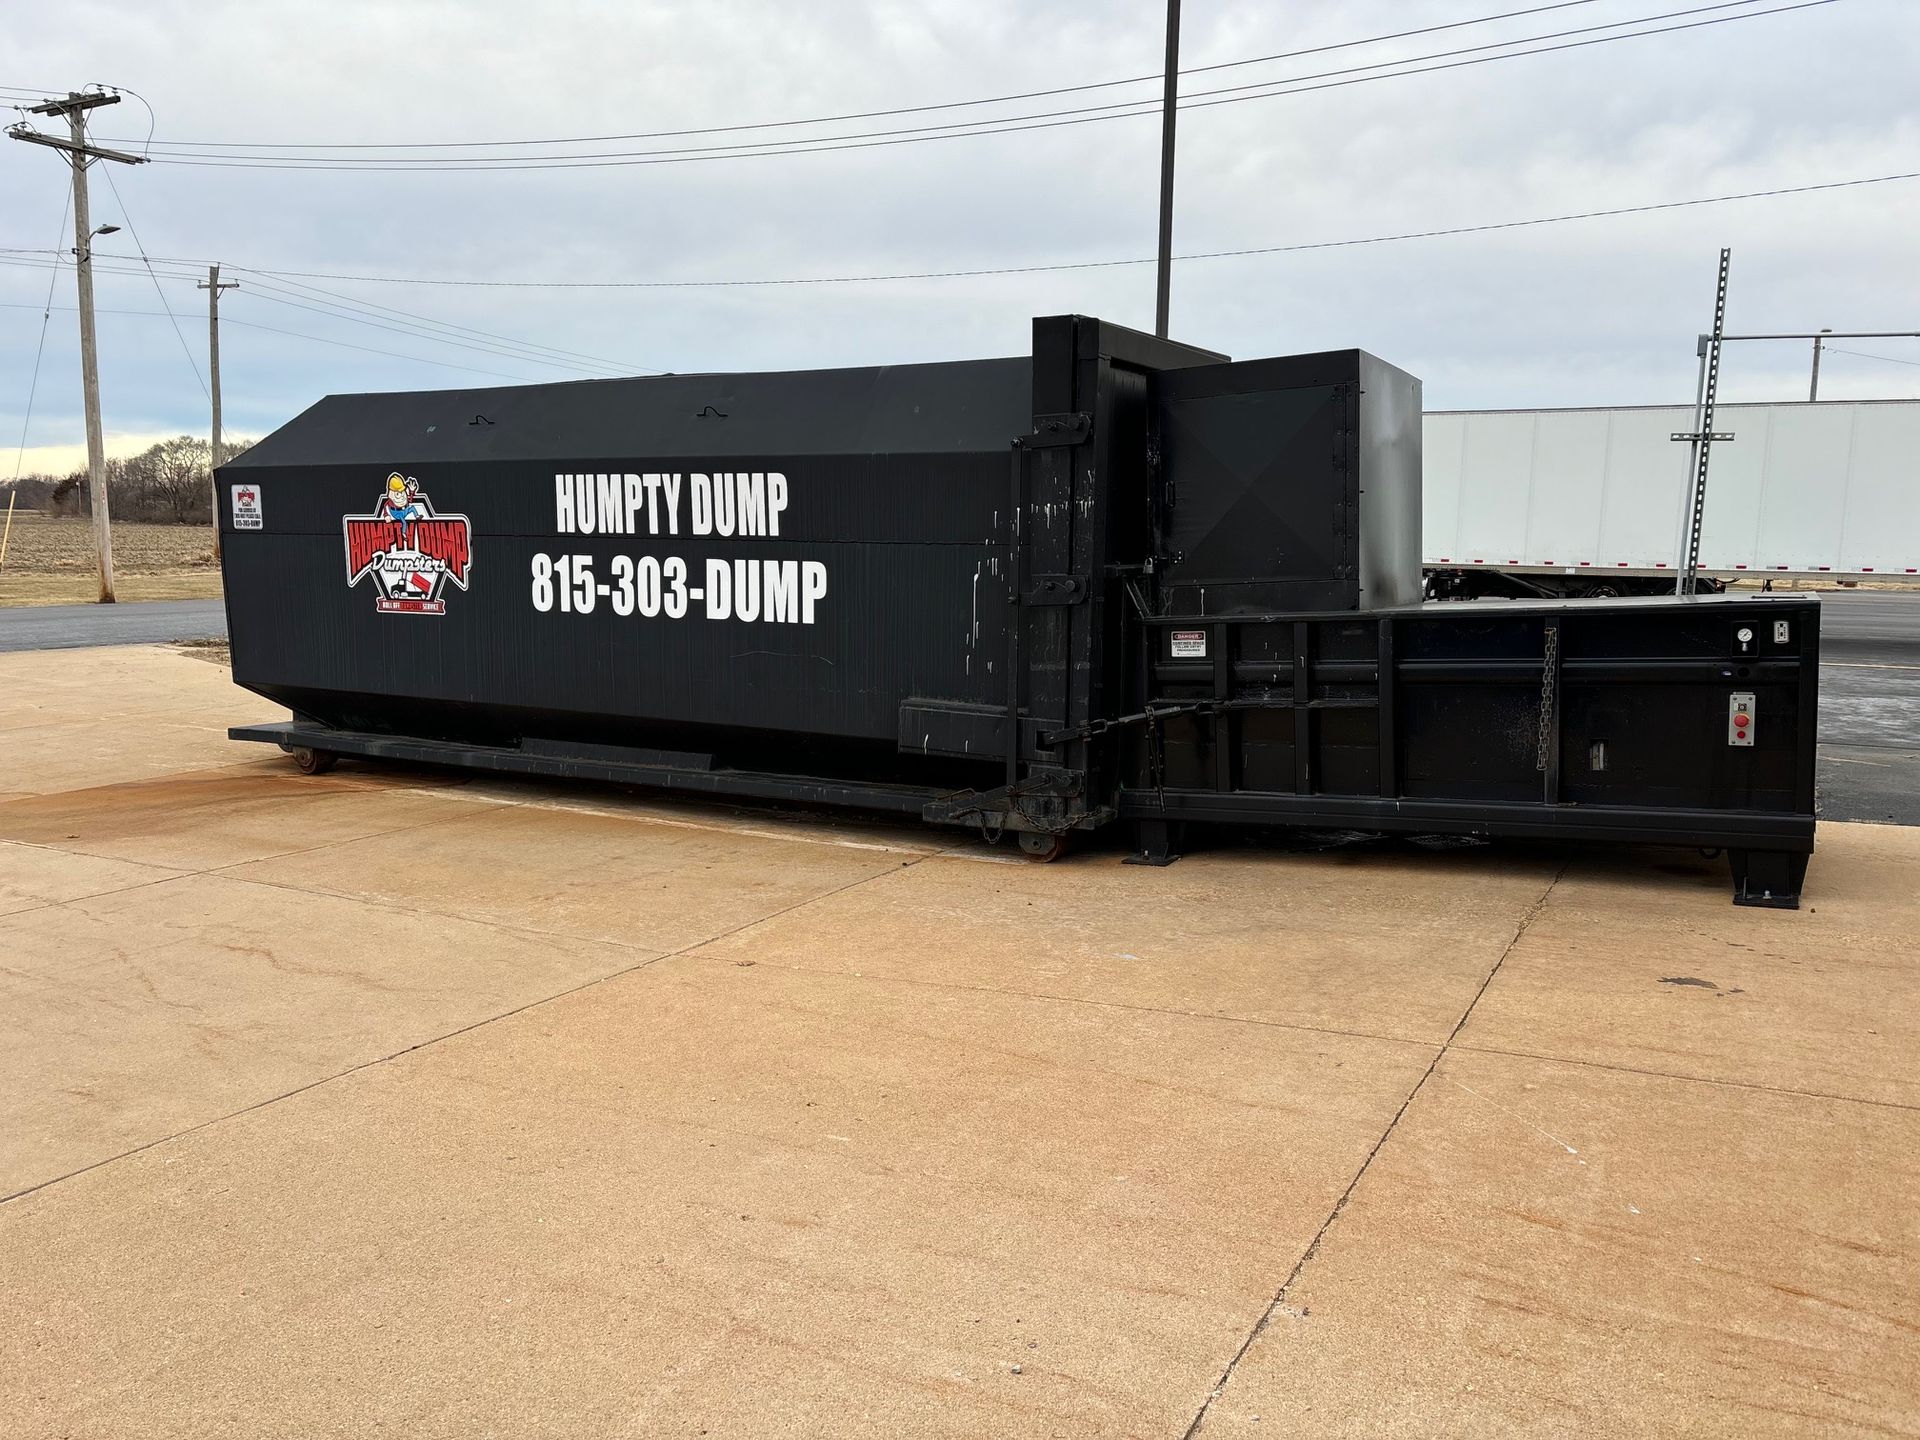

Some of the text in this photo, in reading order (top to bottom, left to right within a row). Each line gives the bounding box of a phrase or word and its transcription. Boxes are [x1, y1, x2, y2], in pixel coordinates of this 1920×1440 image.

[555, 472, 788, 536] HUMPTY DUMP
[348, 522, 469, 580] HUMPTY DUMP
[372, 550, 446, 572] Dumpsters
[531, 552, 828, 625] 815-303-DUMP
